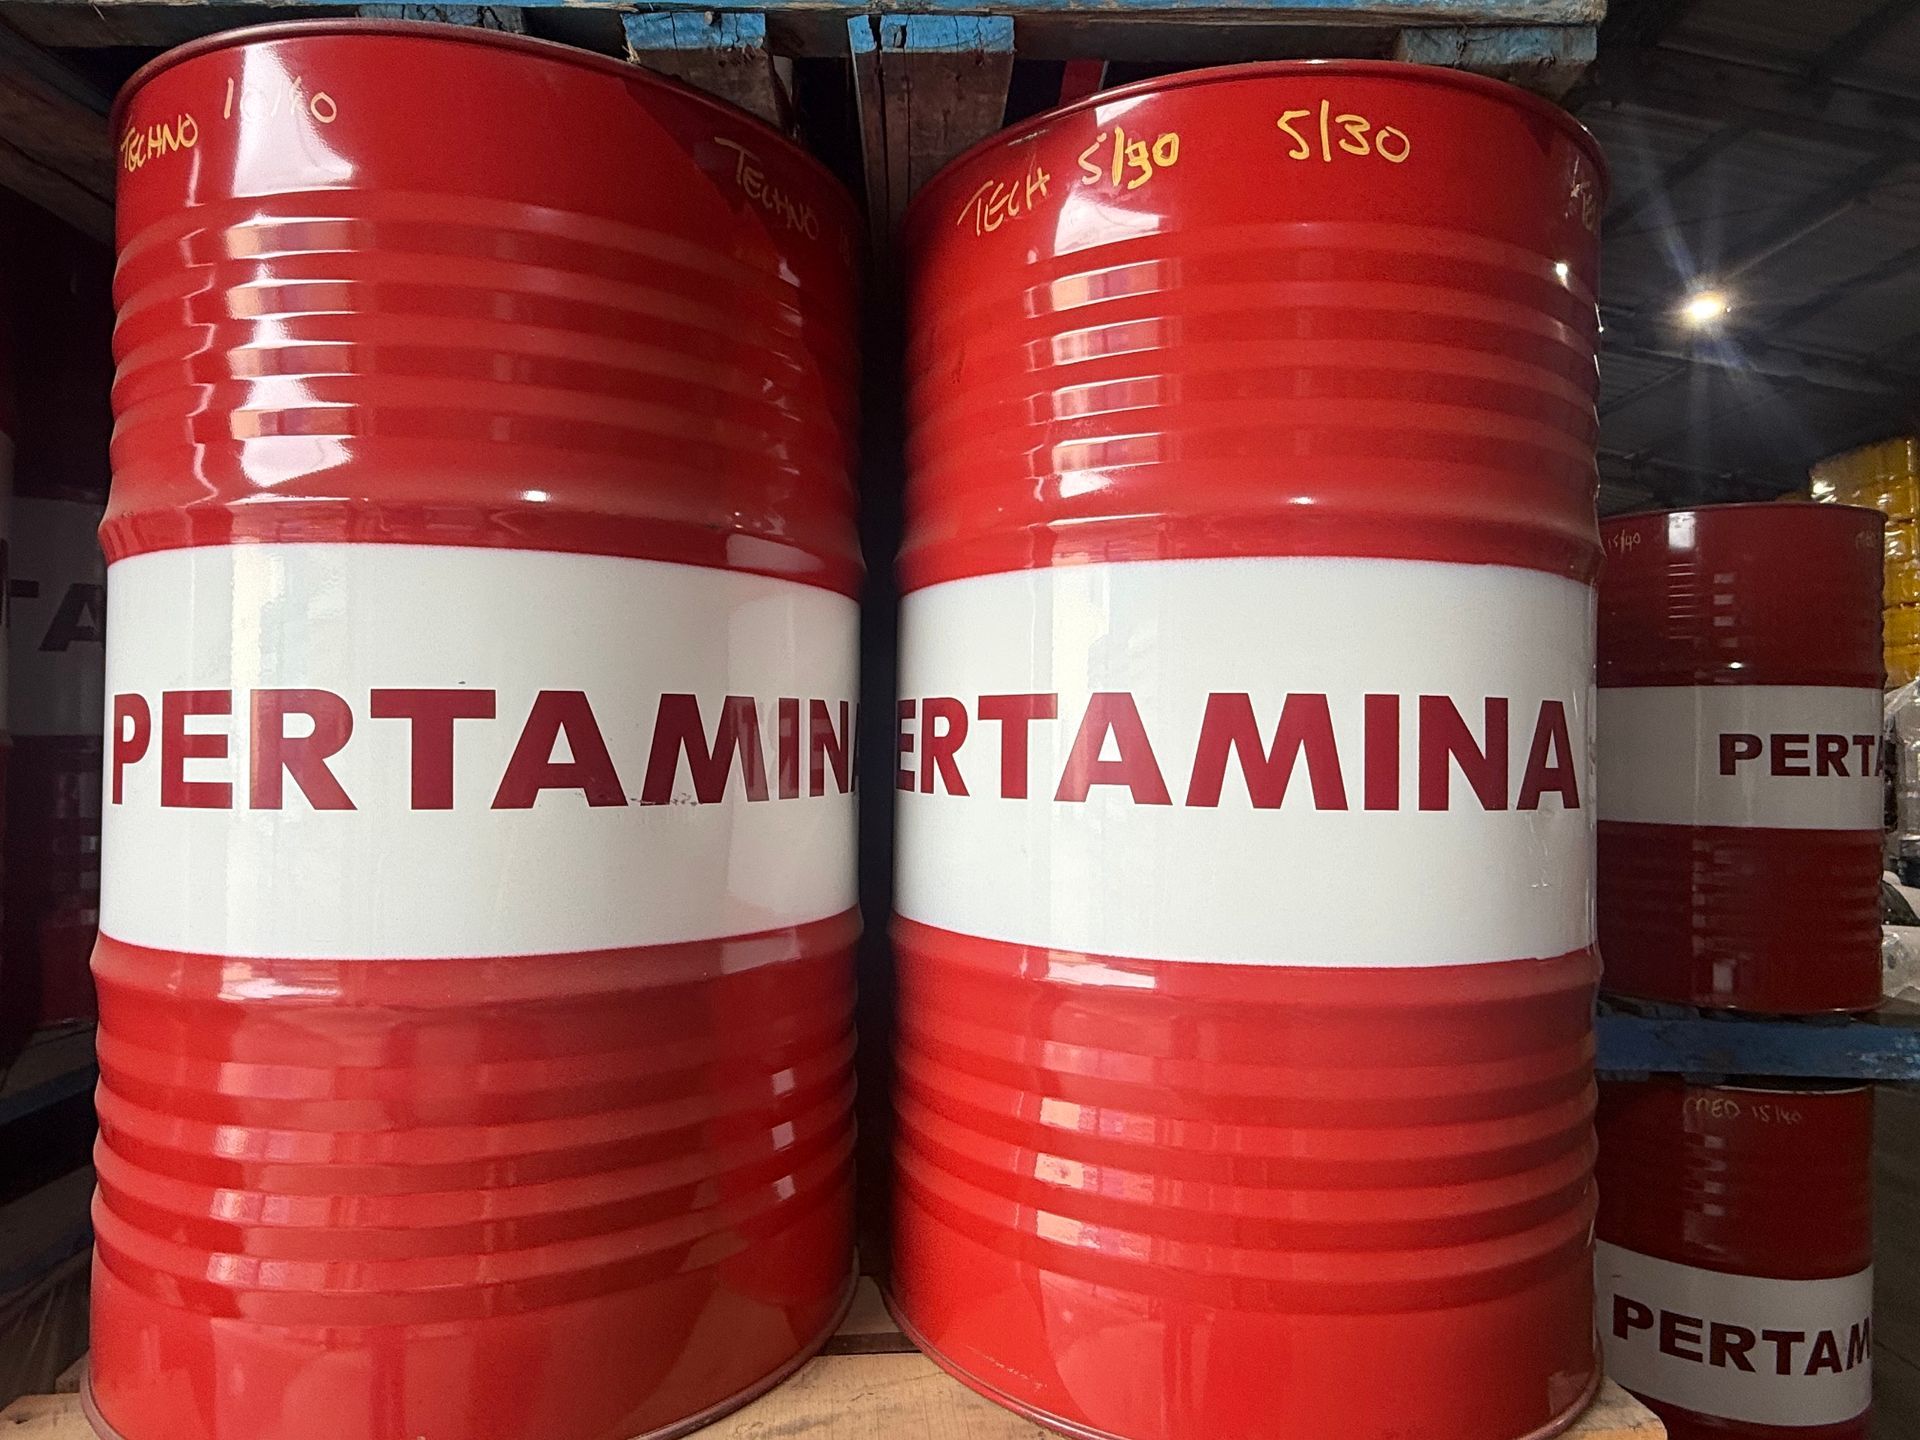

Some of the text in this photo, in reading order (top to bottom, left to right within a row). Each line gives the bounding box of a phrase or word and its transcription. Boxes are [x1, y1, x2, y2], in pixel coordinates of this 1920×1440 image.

[1276, 98, 1412, 163] 5/30
[714, 136, 819, 241] TECHNO
[957, 160, 1051, 237] TECH
[112, 688, 860, 811] PERTAMIN
